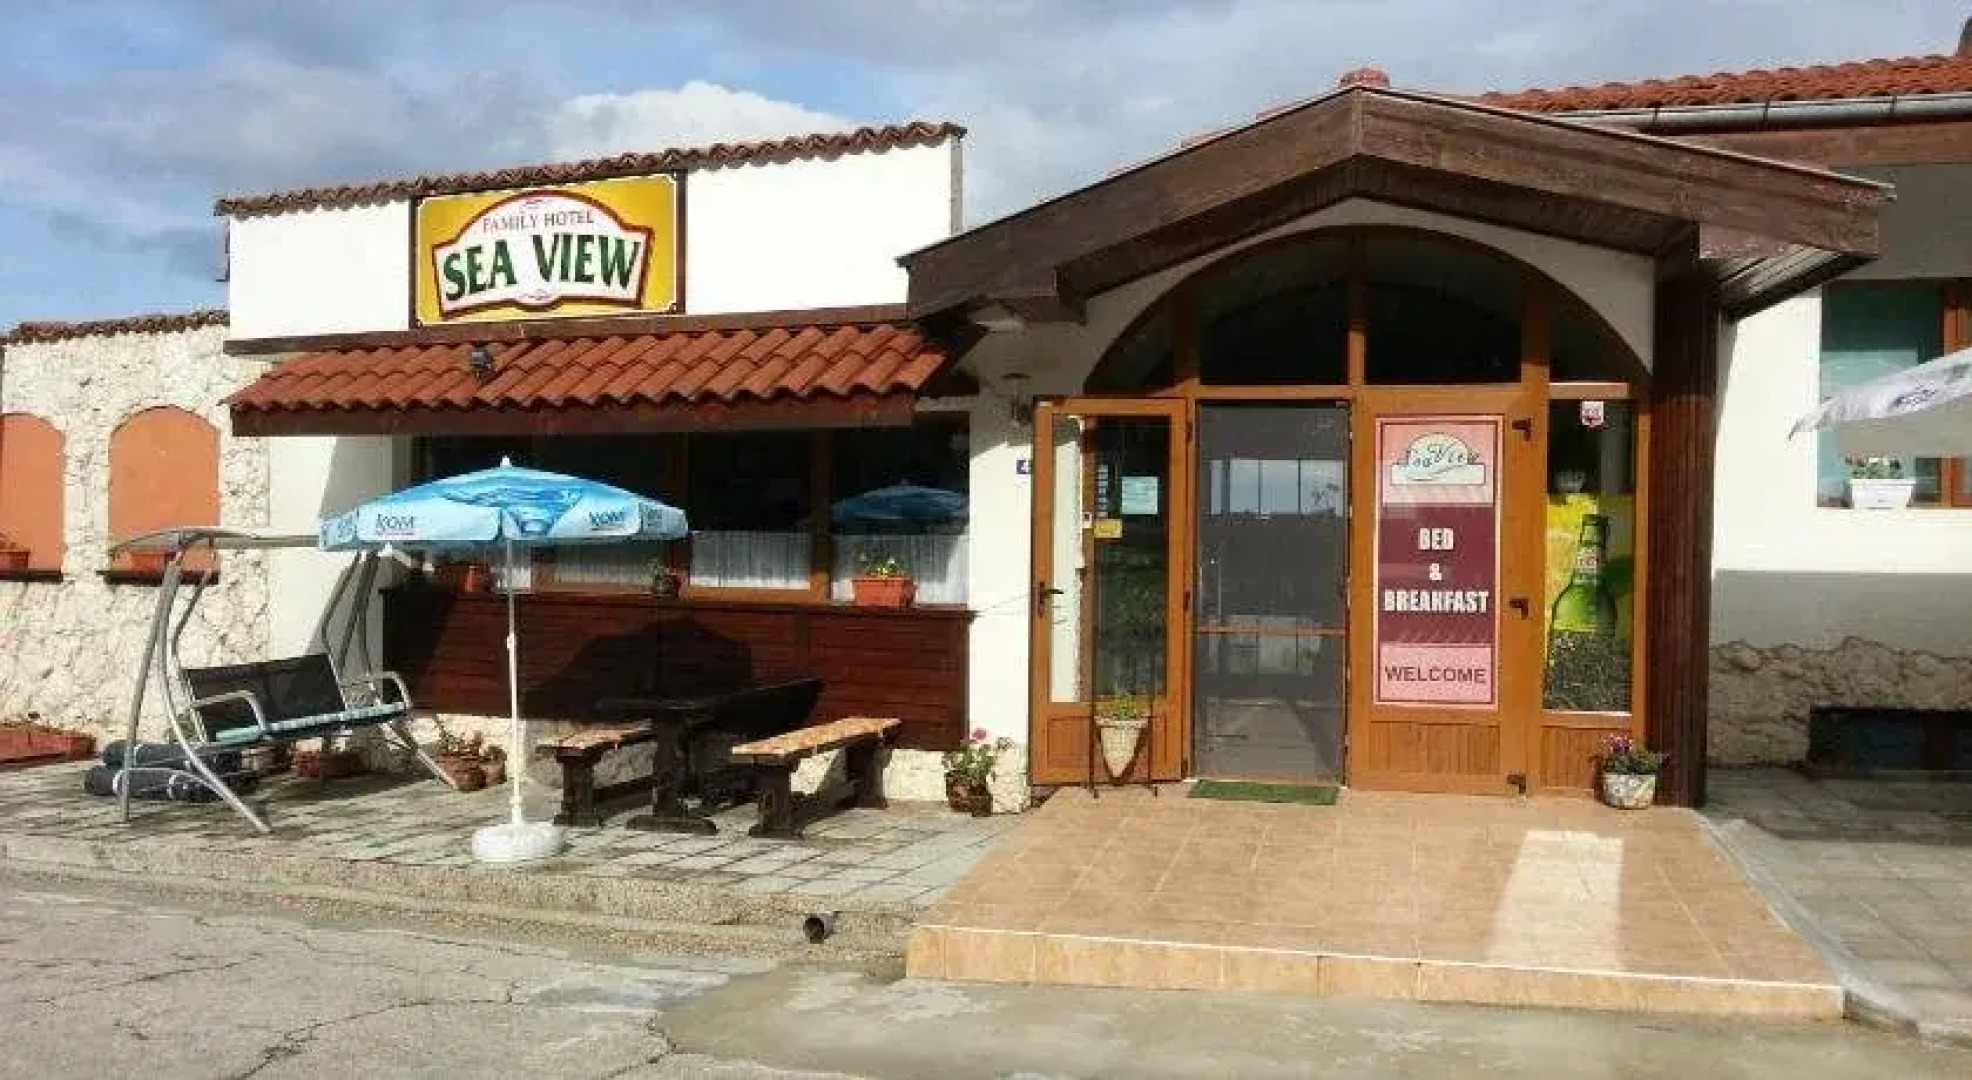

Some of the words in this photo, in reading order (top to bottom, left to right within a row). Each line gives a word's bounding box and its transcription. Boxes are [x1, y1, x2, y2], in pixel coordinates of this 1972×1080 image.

[483, 213, 540, 234] FAMILY
[544, 210, 594, 228] HOTEL
[443, 239, 518, 301] SEA
[532, 233, 641, 290] VIEW
[1418, 528, 1454, 550] BED
[1429, 563, 1442, 580] &
[1384, 589, 1489, 613] BREAKFAST
[1384, 666, 1486, 684] WELCOME
